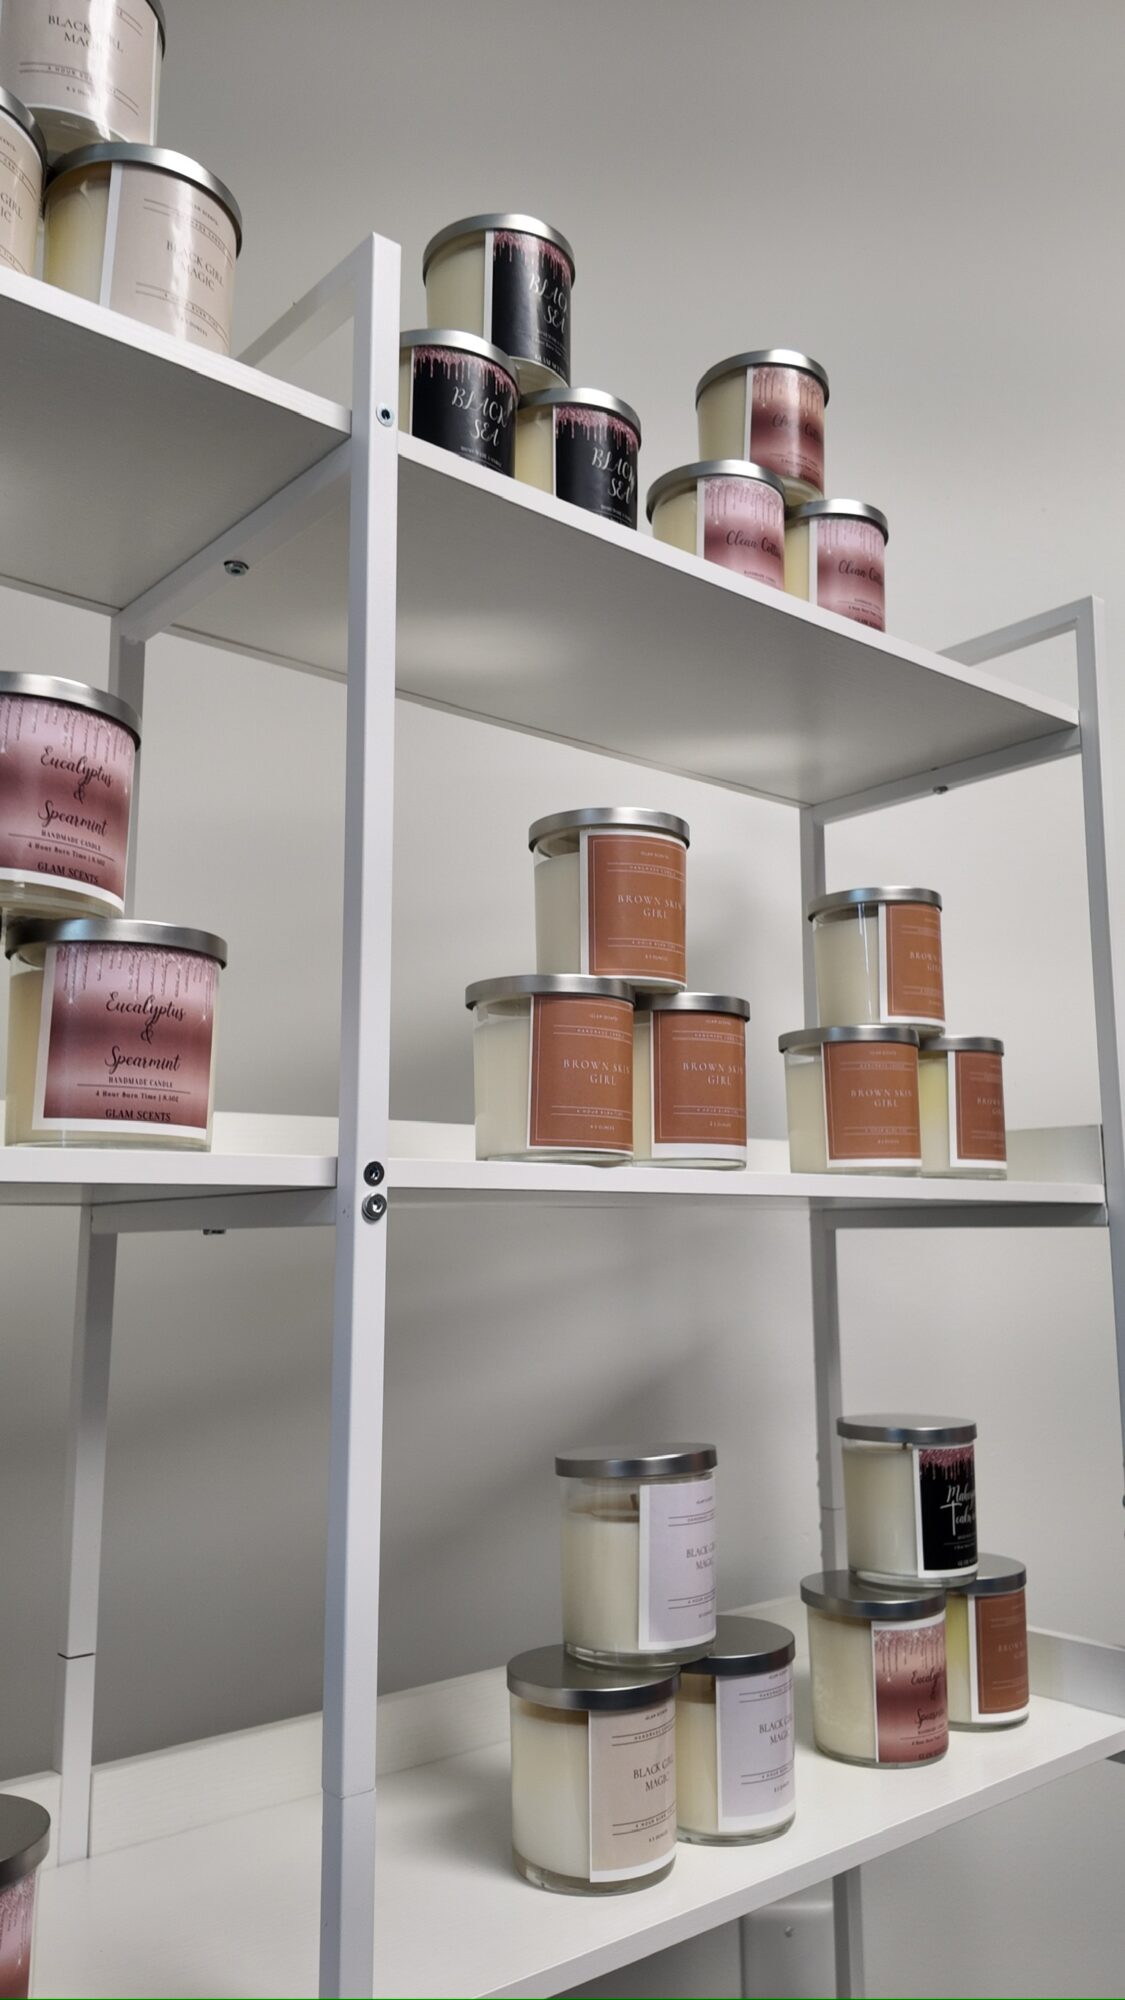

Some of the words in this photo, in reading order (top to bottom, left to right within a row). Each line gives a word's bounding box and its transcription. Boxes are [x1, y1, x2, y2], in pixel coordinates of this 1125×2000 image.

[41, 746, 113, 788] Eucalyptus
[73, 782, 86, 804] &
[38, 800, 107, 837] Spearmint
[41, 829, 79, 844] HANDMADE
[37, 861, 65, 876] GLAM
[68, 867, 98, 883] SCENTS
[618, 894, 661, 906] BROWN
[643, 908, 667, 919] GIRL
[106, 991, 186, 1025] Eucalyptus
[140, 1023, 154, 1044] &
[104, 1045, 182, 1075] Spearmint
[563, 1058, 609, 1072] BROWN
[683, 1061, 725, 1073] BROWN
[108, 1076, 147, 1085] HANDMADE
[149, 1079, 173, 1089] CANDLE
[590, 1074, 616, 1086] GIRL
[707, 1075, 731, 1087] GIRL
[102, 1090, 119, 1098] Hour
[850, 1088, 890, 1098] BROWN
[873, 1099, 897, 1108] GIRL
[105, 1108, 133, 1119] GLAM
[136, 1110, 171, 1122] SCENTS
[633, 1761, 660, 1780] BLACK
